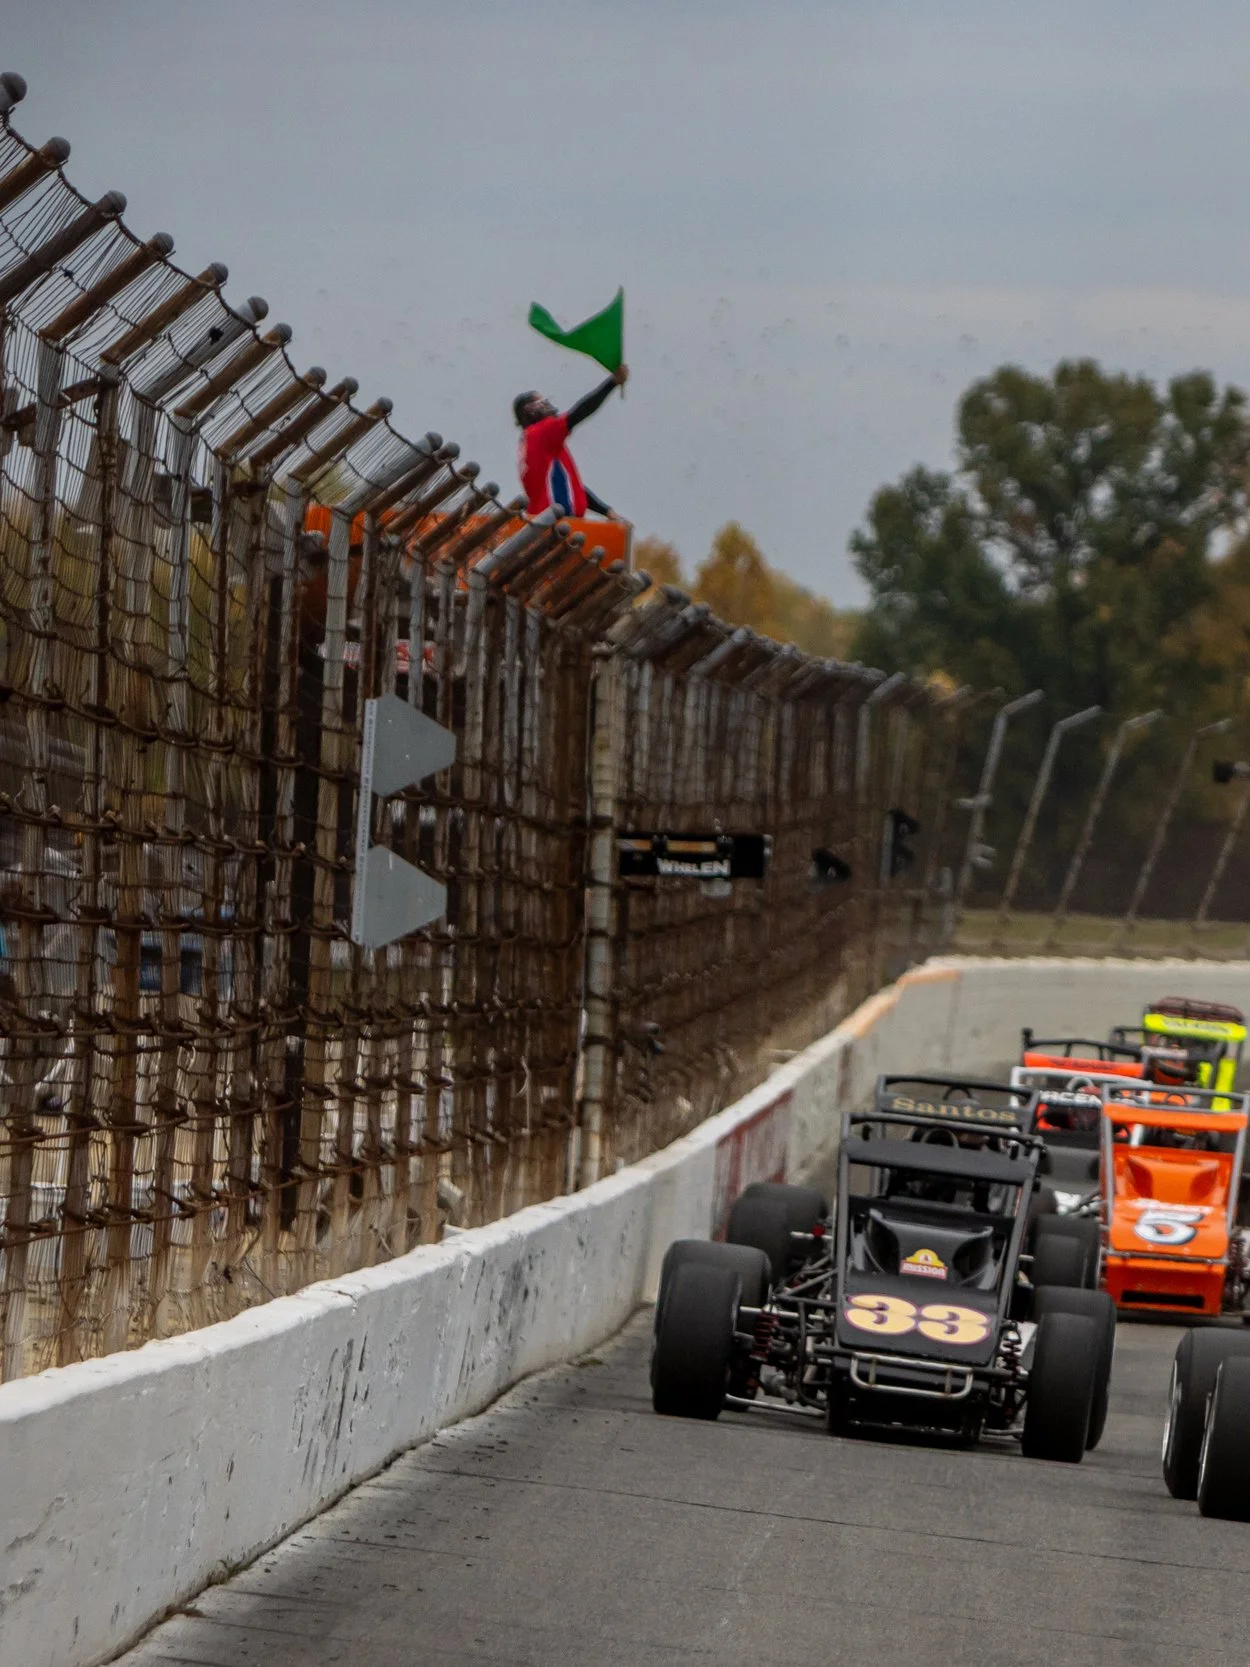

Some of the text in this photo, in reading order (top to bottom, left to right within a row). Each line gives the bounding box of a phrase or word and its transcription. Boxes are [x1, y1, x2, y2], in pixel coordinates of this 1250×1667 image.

[657, 857, 730, 876] WHELEN
[892, 1096, 1017, 1122] Santos
[1134, 1209, 1205, 1246] 5
[844, 1293, 993, 1345] 33
